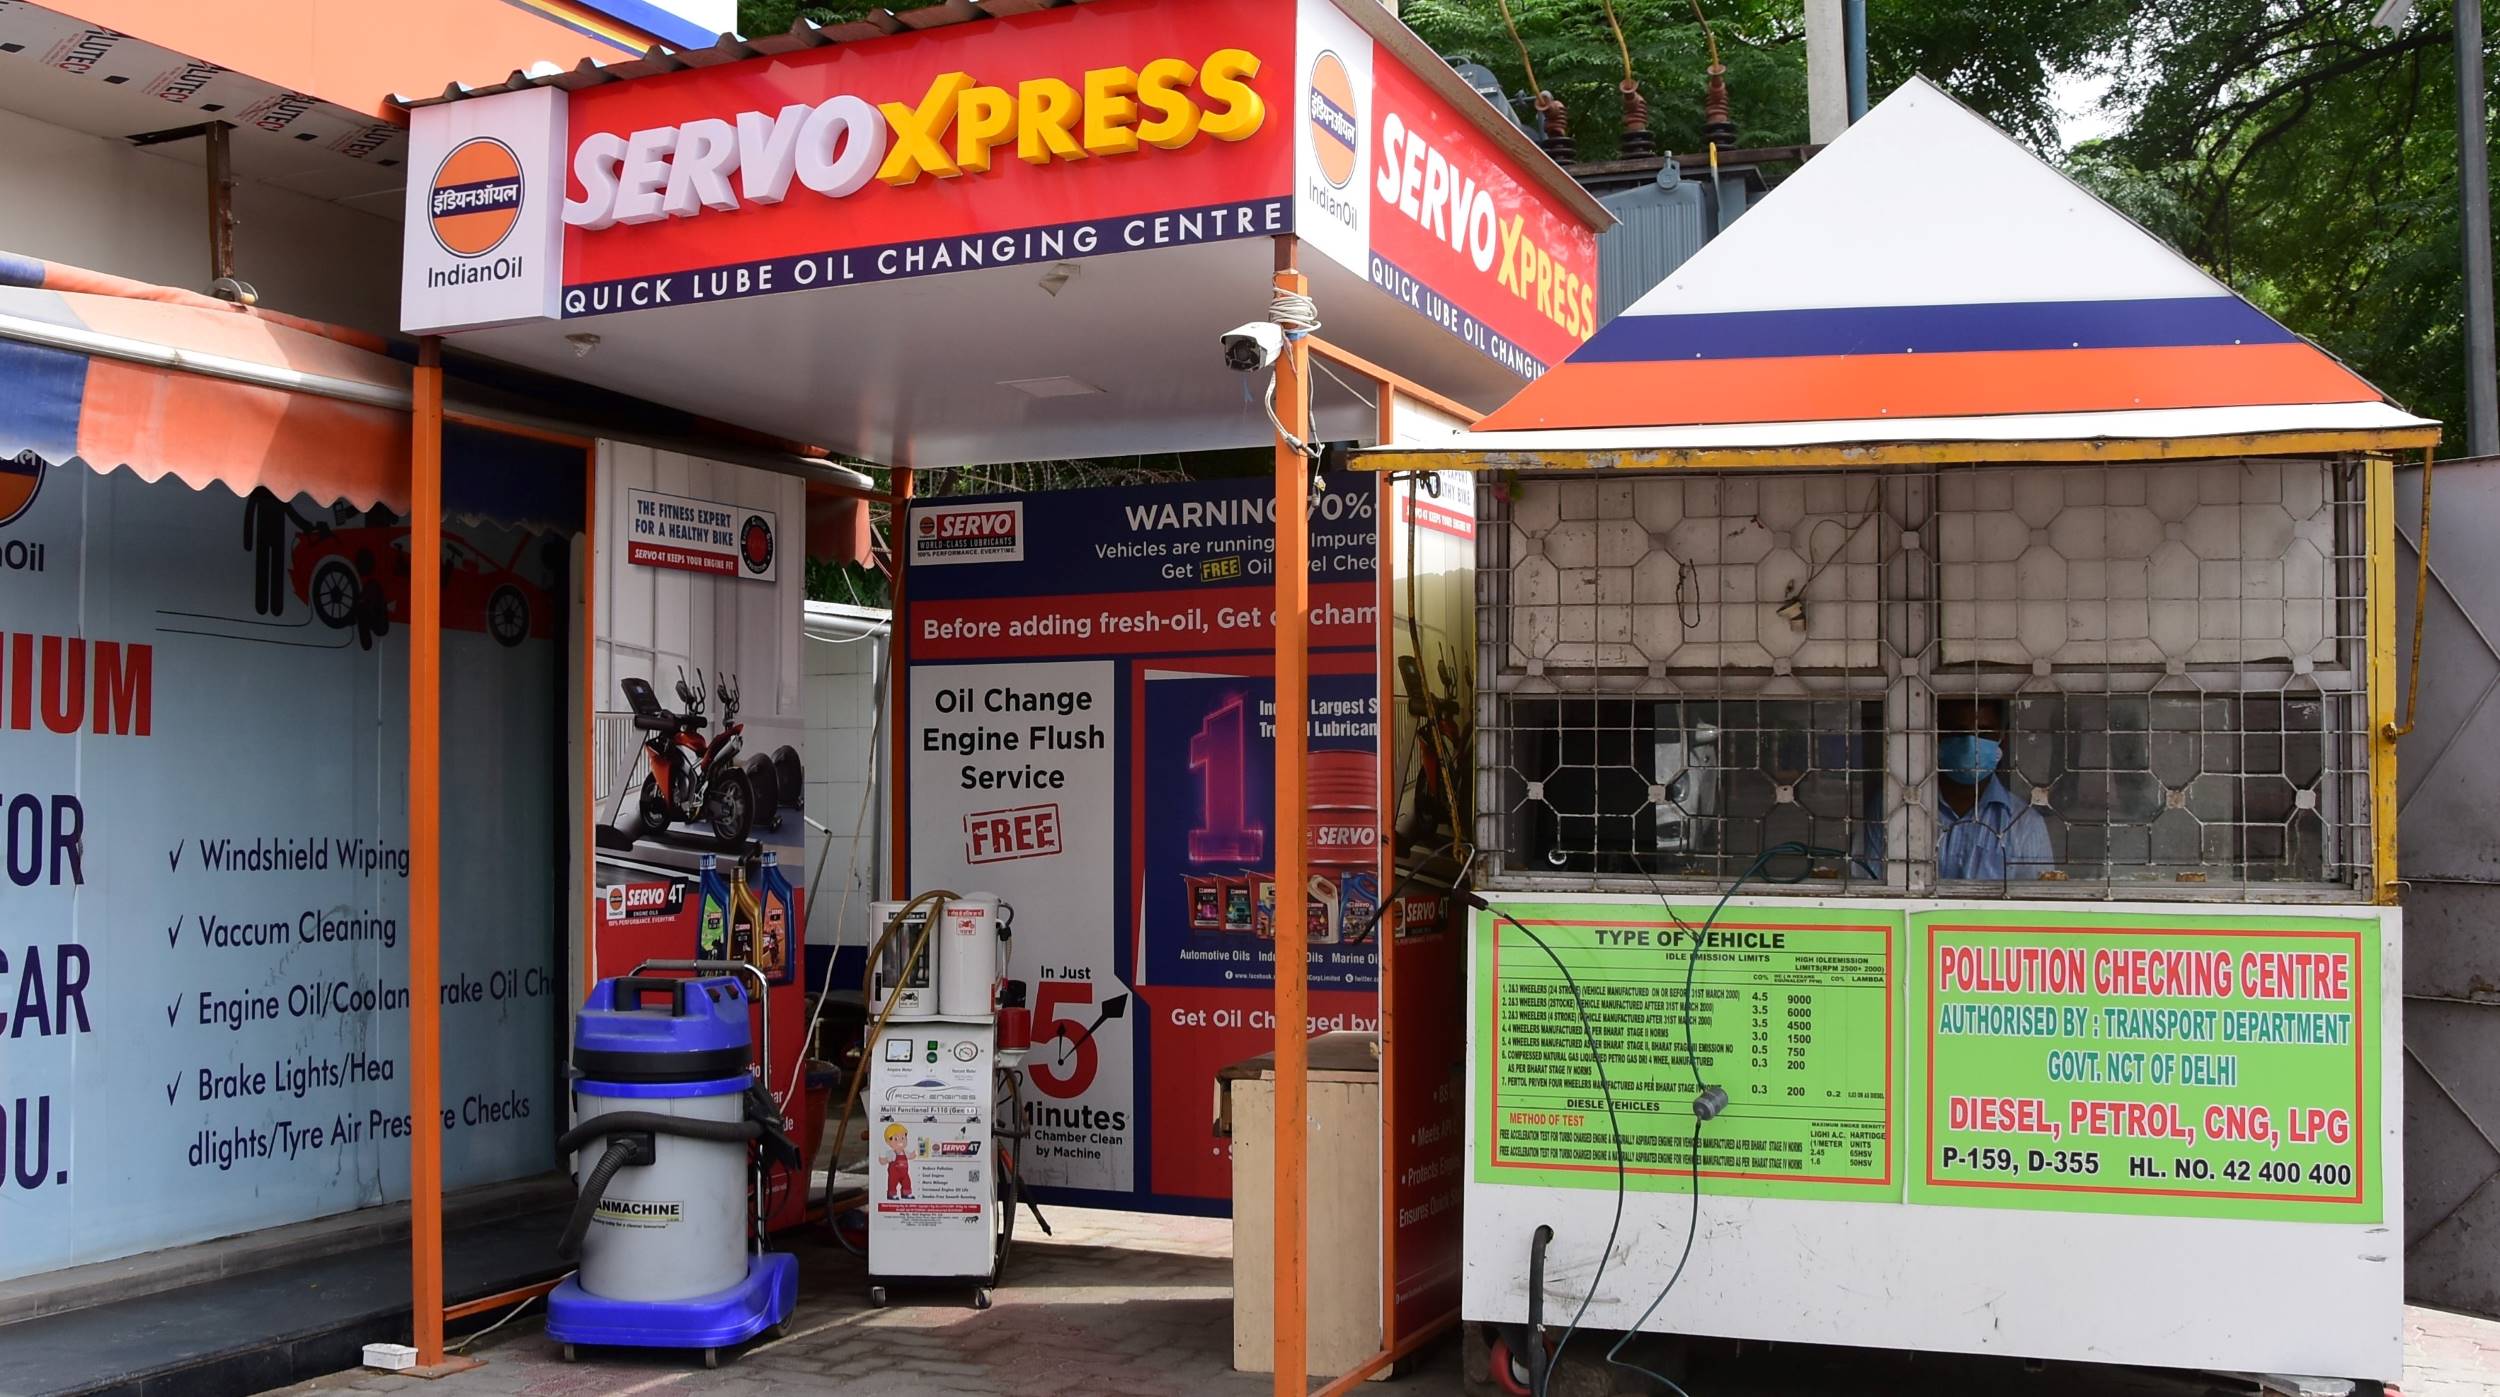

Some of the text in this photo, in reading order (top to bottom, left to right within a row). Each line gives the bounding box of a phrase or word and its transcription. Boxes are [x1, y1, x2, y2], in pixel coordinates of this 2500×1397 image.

[561, 48, 1265, 231] SERVO XPRESS
[432, 182, 519, 216] इंडियनऑयल
[1309, 176, 1357, 232] IndianOil
[1376, 112, 1594, 343] SERVO XPRESS
[565, 202, 1281, 314] QUICK LUBE OIL CHANGING CENTRE
[428, 256, 523, 289] IndianOil
[1372, 257, 1420, 309] QUICK
[1426, 292, 1458, 333] LUBE
[1464, 316, 1486, 351] OIL
[637, 500, 731, 528] THE FITNESS EXPERT
[635, 518, 733, 547] FOR A HEALTHY BIKE
[941, 513, 1012, 537] SERVO
[970, 537, 1012, 547] LUBRICANTS
[1095, 532, 1376, 559] Vehicles are running Impure
[634, 548, 657, 561] SERVO
[658, 551, 666, 562] 4T
[666, 552, 685, 564] KEEPS
[686, 554, 702, 566] YOUR
[1162, 563, 1193, 579] Get
[1202, 558, 1239, 580] FREE
[1248, 558, 1272, 574] Oil
[924, 618, 1001, 639] Before
[1008, 615, 1092, 638] adding
[1100, 608, 1208, 634] fresh-oil,
[1217, 607, 1261, 628] Get
[0, 632, 152, 737] IUM
[935, 687, 1092, 716] Oil Change
[1311, 698, 1364, 716] Largest
[923, 724, 1105, 756] Engine Flush
[960, 764, 1065, 790] Service
[0, 793, 84, 887] OR
[971, 812, 1055, 856] FREE
[1317, 826, 1375, 846] SERVO
[200, 837, 410, 878] Windshield Wiping
[627, 884, 685, 906] SERVO 4T
[1407, 901, 1435, 923] SERVO
[199, 910, 396, 948] Vaccum Cleaning
[1595, 930, 1649, 946] TYPE
[1657, 931, 1684, 947] OF
[1180, 949, 1229, 961] Automotive
[1232, 949, 1250, 961] Oils
[1331, 952, 1365, 964] Marine
[1666, 953, 1770, 962] IDLE LIMITS
[1040, 965, 1091, 980] In Just
[1940, 946, 2349, 1000] POLLUTION CHECKING CENTRE
[490, 968, 517, 1000] Oil
[1520, 984, 1649, 997] WHEELERS MANUFACTURED
[1519, 998, 1643, 1010] WHEELERS MANUFACTURED
[1752, 992, 1768, 1001] 4.5
[1787, 995, 1812, 1005] 9000
[199, 988, 280, 1031] Engine
[1171, 1008, 1206, 1027] Get
[1213, 1009, 1241, 1028] Oil
[1752, 1005, 1768, 1014] 3.5
[1787, 1008, 1812, 1018] 6000
[1512, 1024, 1643, 1037] WHEELERS MANUFACTURED STAGE
[1752, 1018, 1768, 1028] 3.5
[1787, 1021, 1812, 1031] 4500
[1940, 1003, 2350, 1044] AUTHORISED BY TRANSPORT DEPARTMENT
[1028, 981, 1098, 1099] 5
[1752, 1031, 1768, 1041] 3.0
[1788, 1034, 1812, 1044] 1500
[1508, 1050, 1567, 1061] COMPRESSED NATURAL
[1752, 1045, 1768, 1054] 0.5
[1788, 1047, 1806, 1057] 750
[1752, 1058, 1768, 1067] 0.3
[1787, 1060, 1806, 1070] 200
[2048, 1050, 2237, 1086] GOVT. NCT OF DELHI
[199, 1052, 394, 1101] Brake Lights/Hea
[1751, 1084, 1768, 1094] 0.3
[1787, 1086, 1806, 1096] 200
[1567, 1099, 1604, 1109] DIESLE
[1509, 1112, 1584, 1127] METHOD OF TEST
[1950, 1096, 2349, 1150] DIESEL, PETROL, CNG, LPG
[189, 1090, 530, 1171] dlights/Tyre Air Checks
[1034, 1130, 1123, 1145] Chamber Clean
[1849, 1131, 1886, 1140] HARTIDGE
[942, 1143, 979, 1152] SERVO 4T
[1036, 1145, 1101, 1160] by Machine
[1849, 1141, 1871, 1149] UNITS
[1849, 1150, 1872, 1158] 65HSV
[1943, 1147, 2351, 1185] P-159, D-355 HL. NO. 42 400 400
